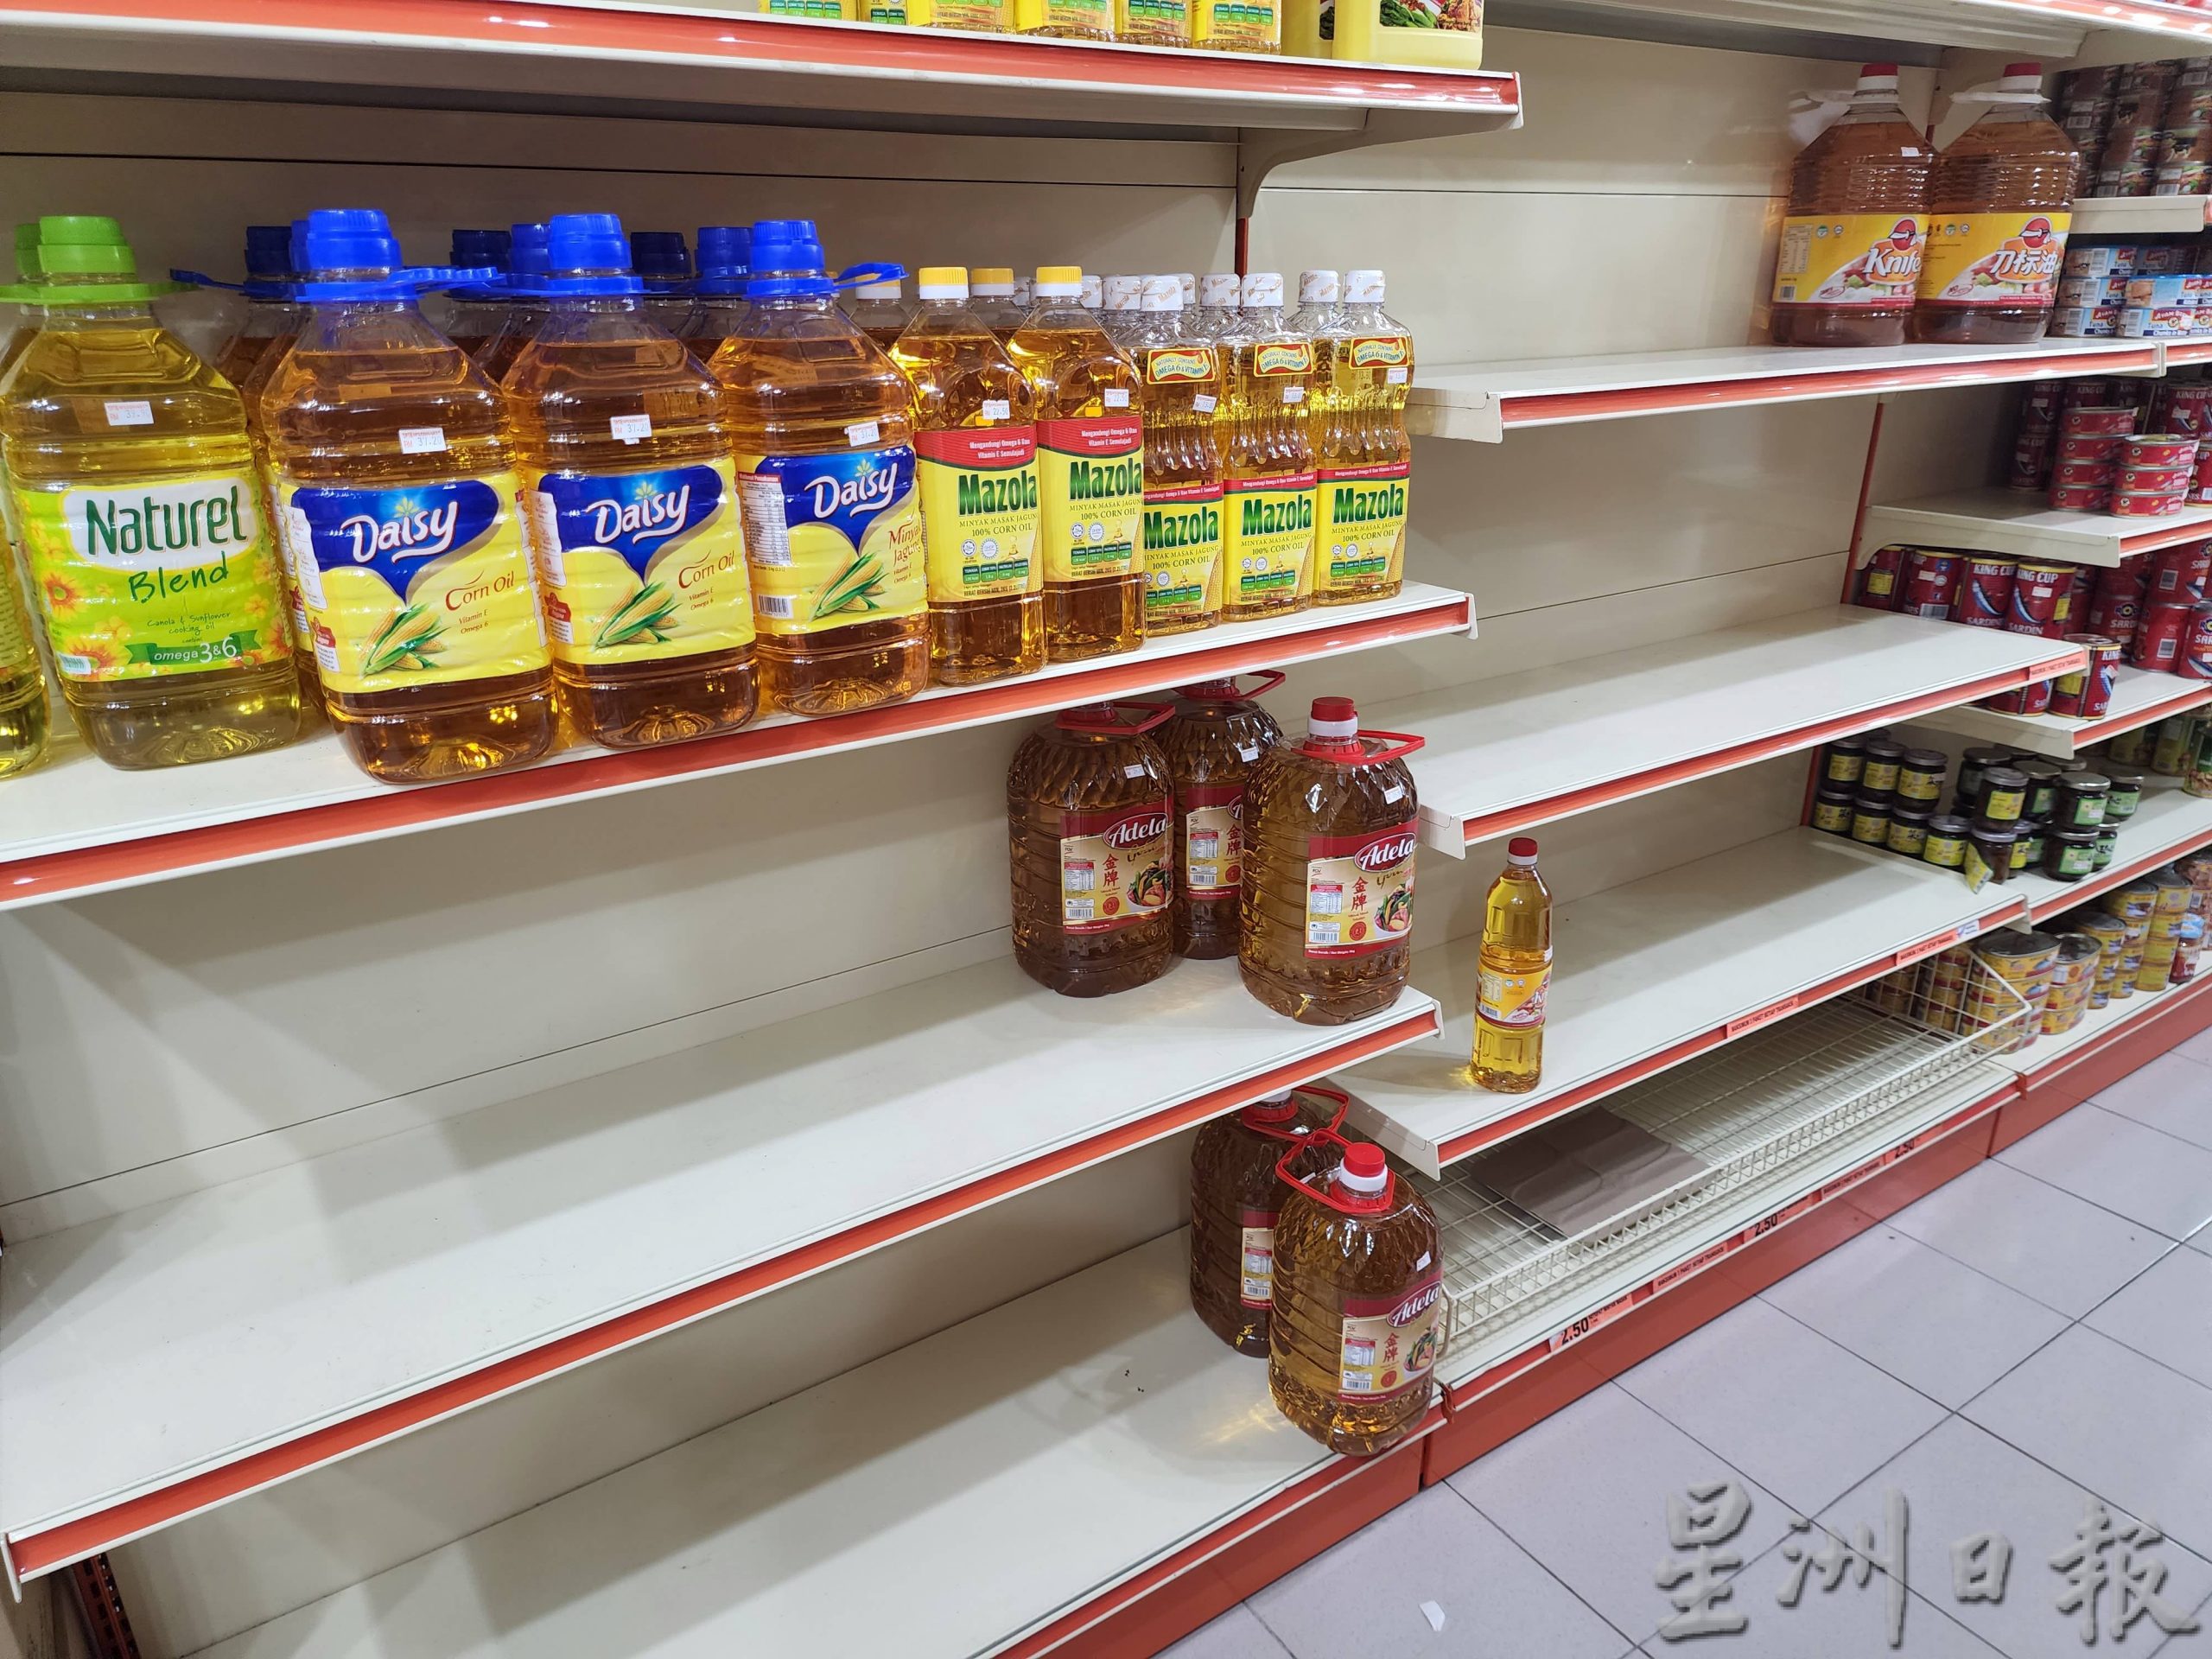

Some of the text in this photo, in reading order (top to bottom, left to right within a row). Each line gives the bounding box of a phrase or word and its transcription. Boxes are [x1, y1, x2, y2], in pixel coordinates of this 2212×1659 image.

[1863, 247, 1922, 276] Knife
[1262, 359, 1279, 370] OMEGA
[1287, 359, 1305, 368] VITAMIN
[1357, 352, 1375, 362] OMEGA
[1155, 366, 1176, 377] OMEGA
[1185, 366, 1205, 376] VITAMIN
[2176, 391, 2196, 399] KING
[805, 462, 898, 518] Daisy
[1070, 457, 1141, 500] Mazola
[958, 470, 1037, 516] Mazola
[1333, 483, 1404, 524] Mazola
[86, 485, 248, 556] Naturel
[585, 485, 690, 544] Daisy
[959, 512, 1038, 528] MINYAK MASAK JAGUN
[1100, 510, 1122, 518] CORN
[1243, 493, 1313, 536] Mazola
[1360, 523, 1381, 531] MASAK
[1382, 519, 1403, 529] JAGUNG
[340, 501, 459, 564] Daisy
[993, 524, 1017, 535] CORN
[1144, 505, 1218, 550] Mazola
[1241, 531, 1312, 547] MINYAK MASAK JAGUNG
[1361, 531, 1382, 540] CORN
[1170, 549, 1194, 558] MASAK
[1195, 544, 1219, 556] JAGUNG
[1270, 543, 1291, 553] CORN
[1292, 541, 1304, 550] OIL
[678, 550, 734, 588] Corn Oil
[1153, 555, 1210, 570] 100% CORN OIL
[1974, 563, 1999, 575] KING
[128, 550, 229, 603] Blend
[2036, 571, 2058, 584] CUP
[445, 570, 514, 611] Corn Oil
[689, 589, 709, 601] Vitamin
[690, 599, 709, 610] Omega
[147, 618, 175, 626] Canola
[189, 612, 232, 623] Sunflower
[459, 611, 482, 625] Vitamin
[461, 623, 483, 634] Omega
[169, 626, 202, 636] cooking
[2195, 634, 2212, 644] SAR
[154, 636, 238, 664] omega 3&6
[1109, 817, 1166, 848] Adela
[1226, 823, 1242, 856] 金牌
[1360, 838, 1414, 870] Adela
[1103, 853, 1119, 887] 金牌
[1351, 876, 1369, 912] 金牌
[1755, 1213, 1777, 1236] 2.50
[1392, 1286, 1440, 1327] Adela
[1561, 1316, 1590, 1345] 2.50
[1382, 1332, 1400, 1363] 金牌
